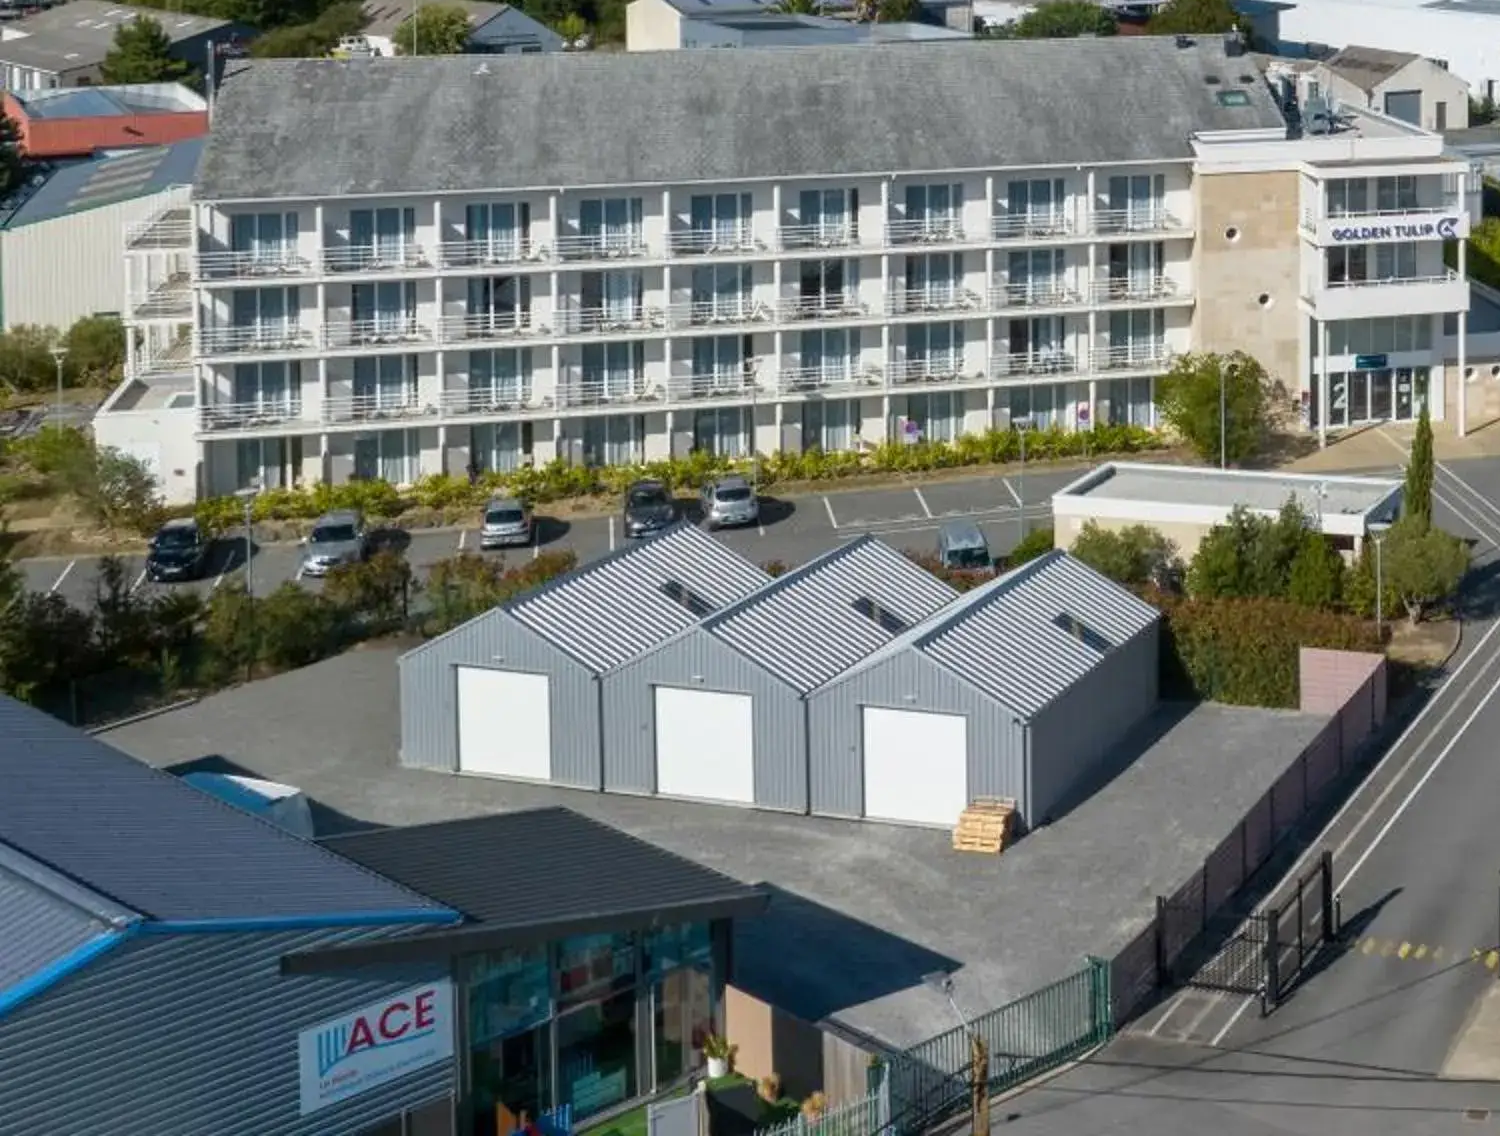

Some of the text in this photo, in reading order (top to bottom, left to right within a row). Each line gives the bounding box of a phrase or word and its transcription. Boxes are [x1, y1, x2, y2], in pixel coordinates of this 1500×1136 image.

[1332, 224, 1434, 241] GOLDEN TULIP
[346, 989, 437, 1056] ACE
